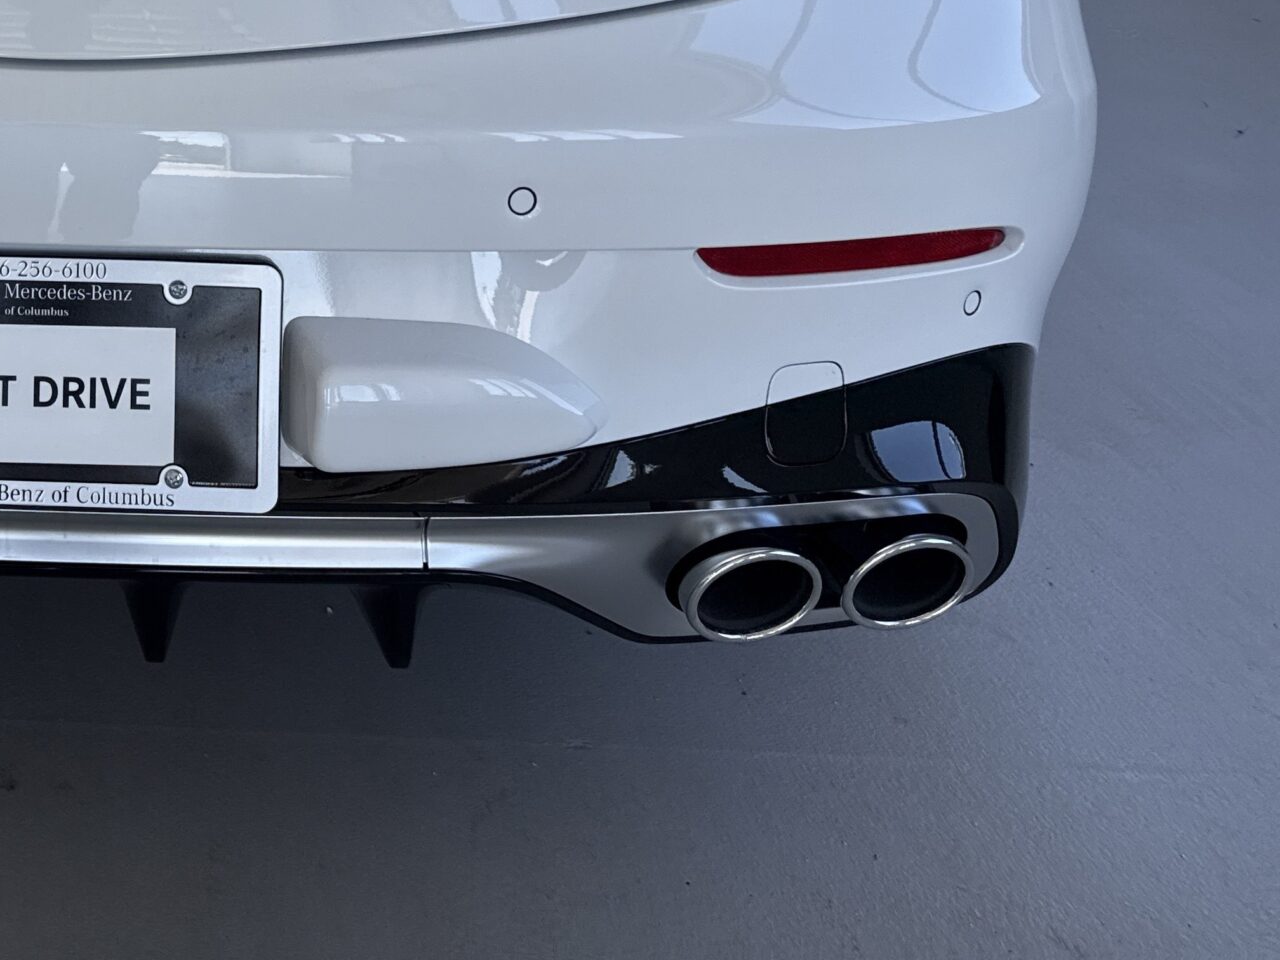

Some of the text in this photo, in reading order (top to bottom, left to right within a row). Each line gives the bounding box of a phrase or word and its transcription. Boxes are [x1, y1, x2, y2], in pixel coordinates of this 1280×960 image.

[4, 283, 132, 302] Mercedes-Benz
[4, 306, 69, 317] of Columbus
[33, 375, 151, 411] DRIVE
[51, 484, 70, 504] of
[76, 485, 176, 508] Columbus
